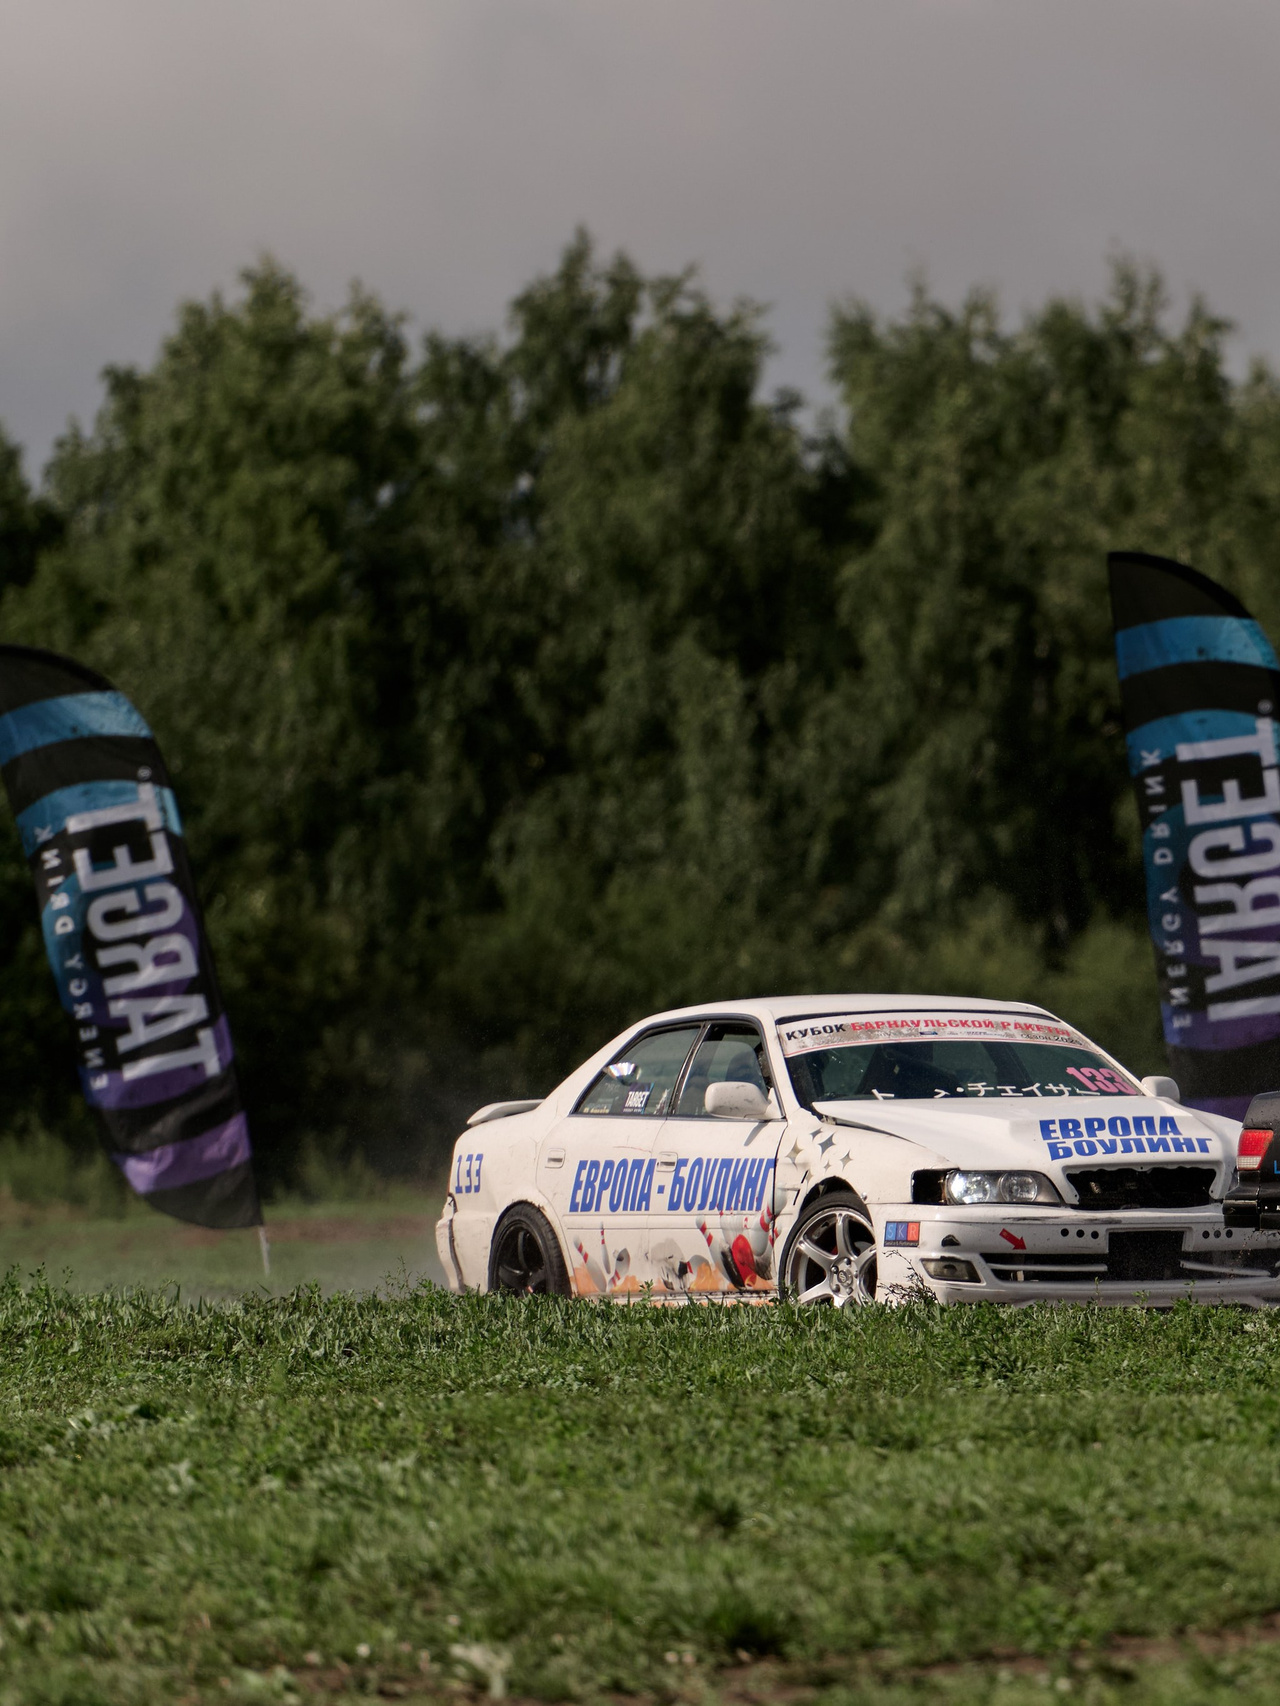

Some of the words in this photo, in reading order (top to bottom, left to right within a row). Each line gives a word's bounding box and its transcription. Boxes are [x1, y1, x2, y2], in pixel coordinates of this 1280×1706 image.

[785, 1023, 847, 1041] КУБОК
[850, 1018, 995, 1031] БАРНАУЛЬСКОЙ
[1001, 1021, 1072, 1037] РАКЕТЫ
[1065, 1065, 1138, 1096] 133
[1039, 1115, 1183, 1141] ЕВРОПА
[1046, 1137, 1213, 1161] БОУЛИНГ
[455, 1153, 484, 1194] 133
[887, 1224, 918, 1239] SKR
